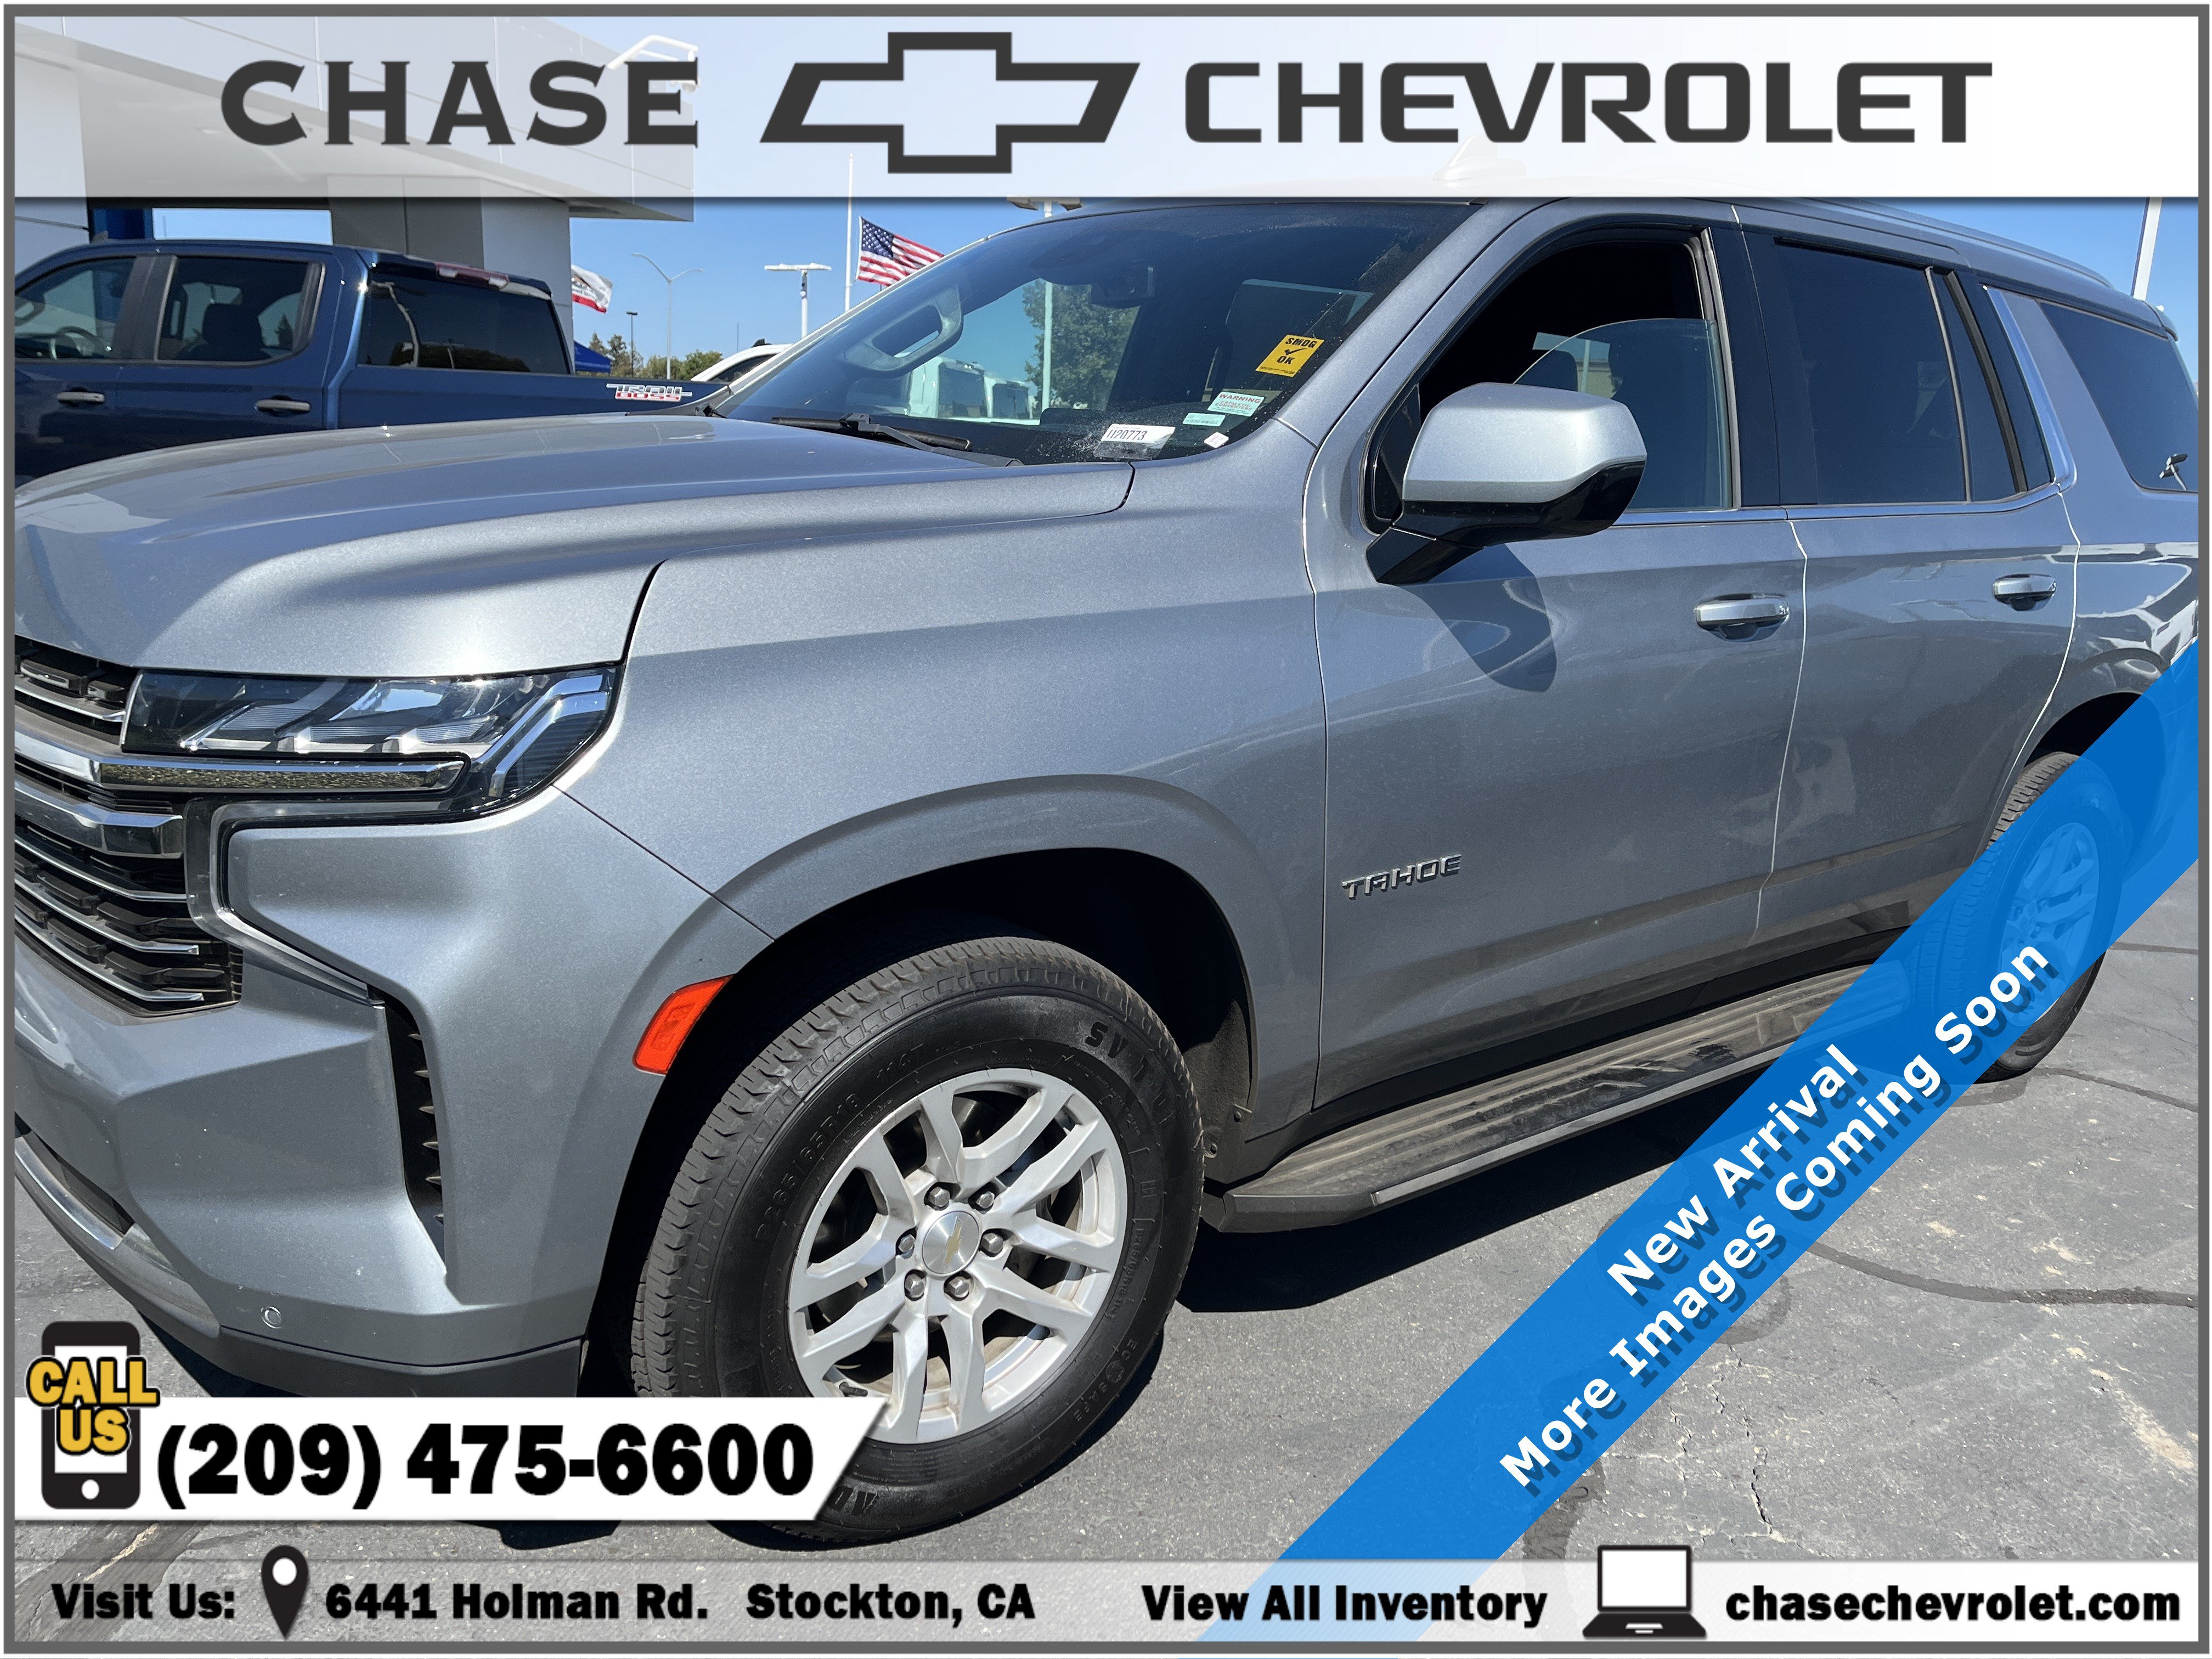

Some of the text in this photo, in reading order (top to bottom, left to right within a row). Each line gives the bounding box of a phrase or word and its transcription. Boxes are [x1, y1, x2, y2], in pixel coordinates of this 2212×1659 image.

[1285, 337, 1318, 348] SMOG
[1276, 356, 1296, 365] OK
[1219, 393, 1261, 403] WARNING
[1215, 403, 1252, 411] CONVERTERS
[1342, 853, 1462, 900] TAHOE
